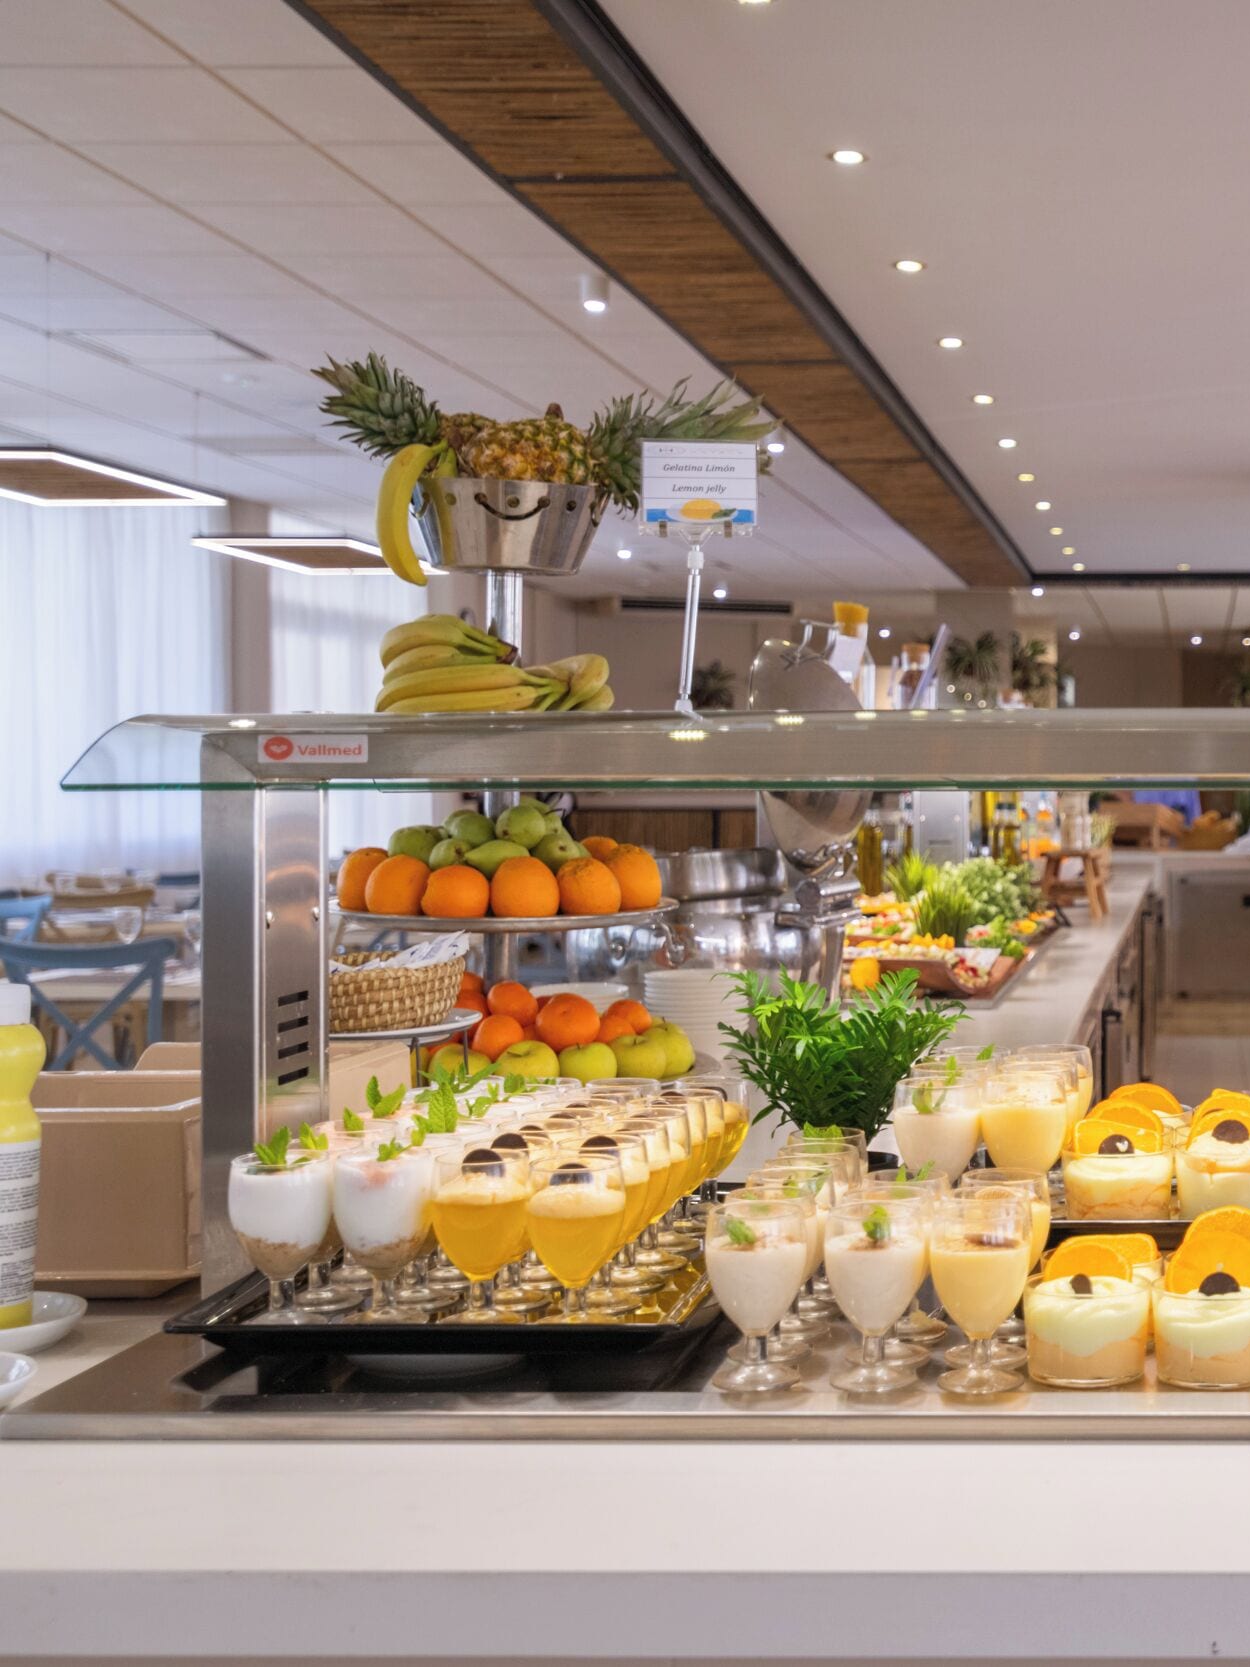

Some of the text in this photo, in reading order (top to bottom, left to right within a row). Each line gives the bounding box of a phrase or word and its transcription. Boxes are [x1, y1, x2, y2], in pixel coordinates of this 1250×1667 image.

[663, 463, 735, 473] Gelatina Limón
[672, 484, 727, 494] Lemon jelly
[297, 744, 363, 756] Vallmed
